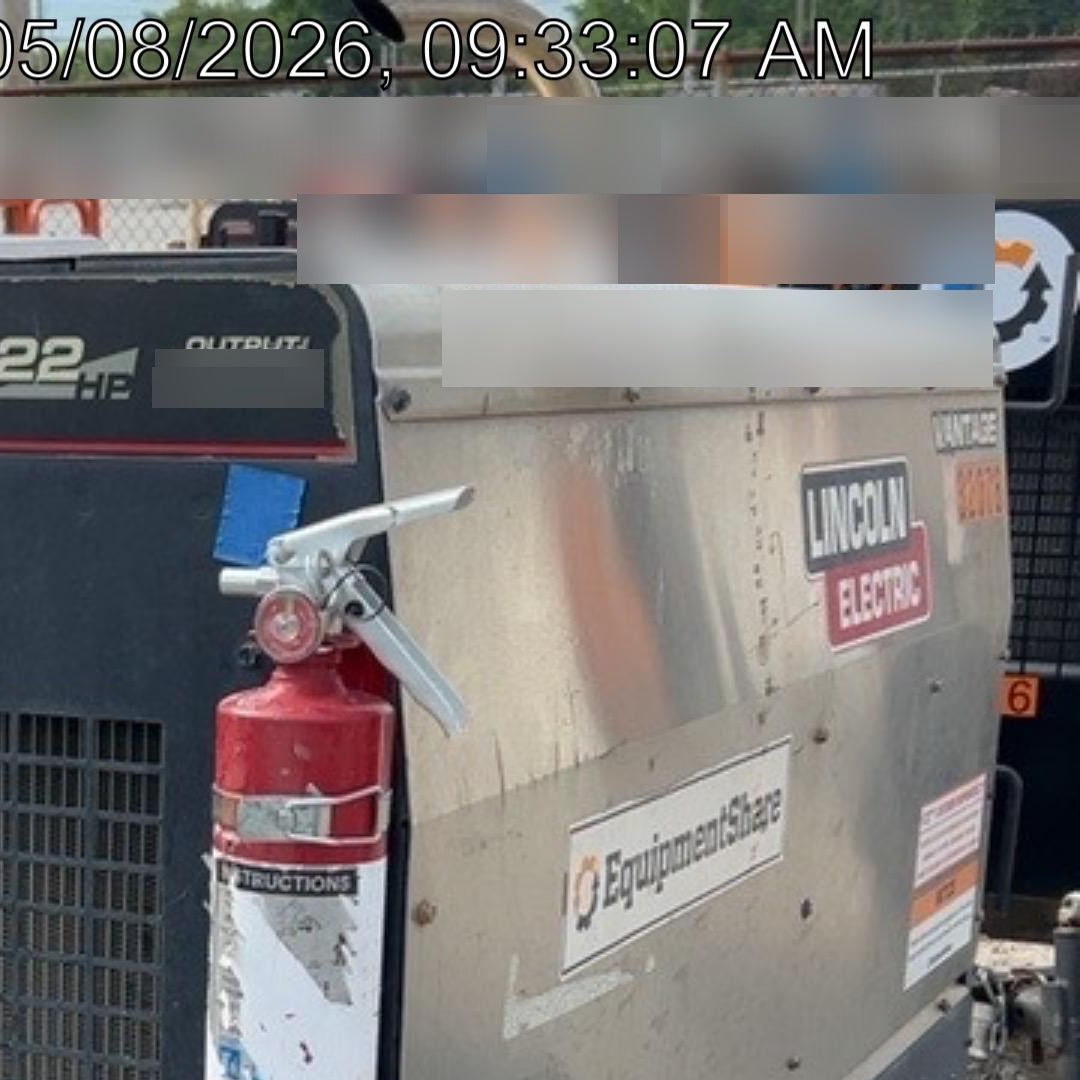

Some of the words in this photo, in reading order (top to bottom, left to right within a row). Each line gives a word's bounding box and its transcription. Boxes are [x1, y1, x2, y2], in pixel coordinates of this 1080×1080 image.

[806, 475, 908, 560] LINCOLN
[838, 559, 921, 630] ELECTRIC
[1008, 679, 1031, 713] 6
[602, 788, 782, 911] EquipmentShare
